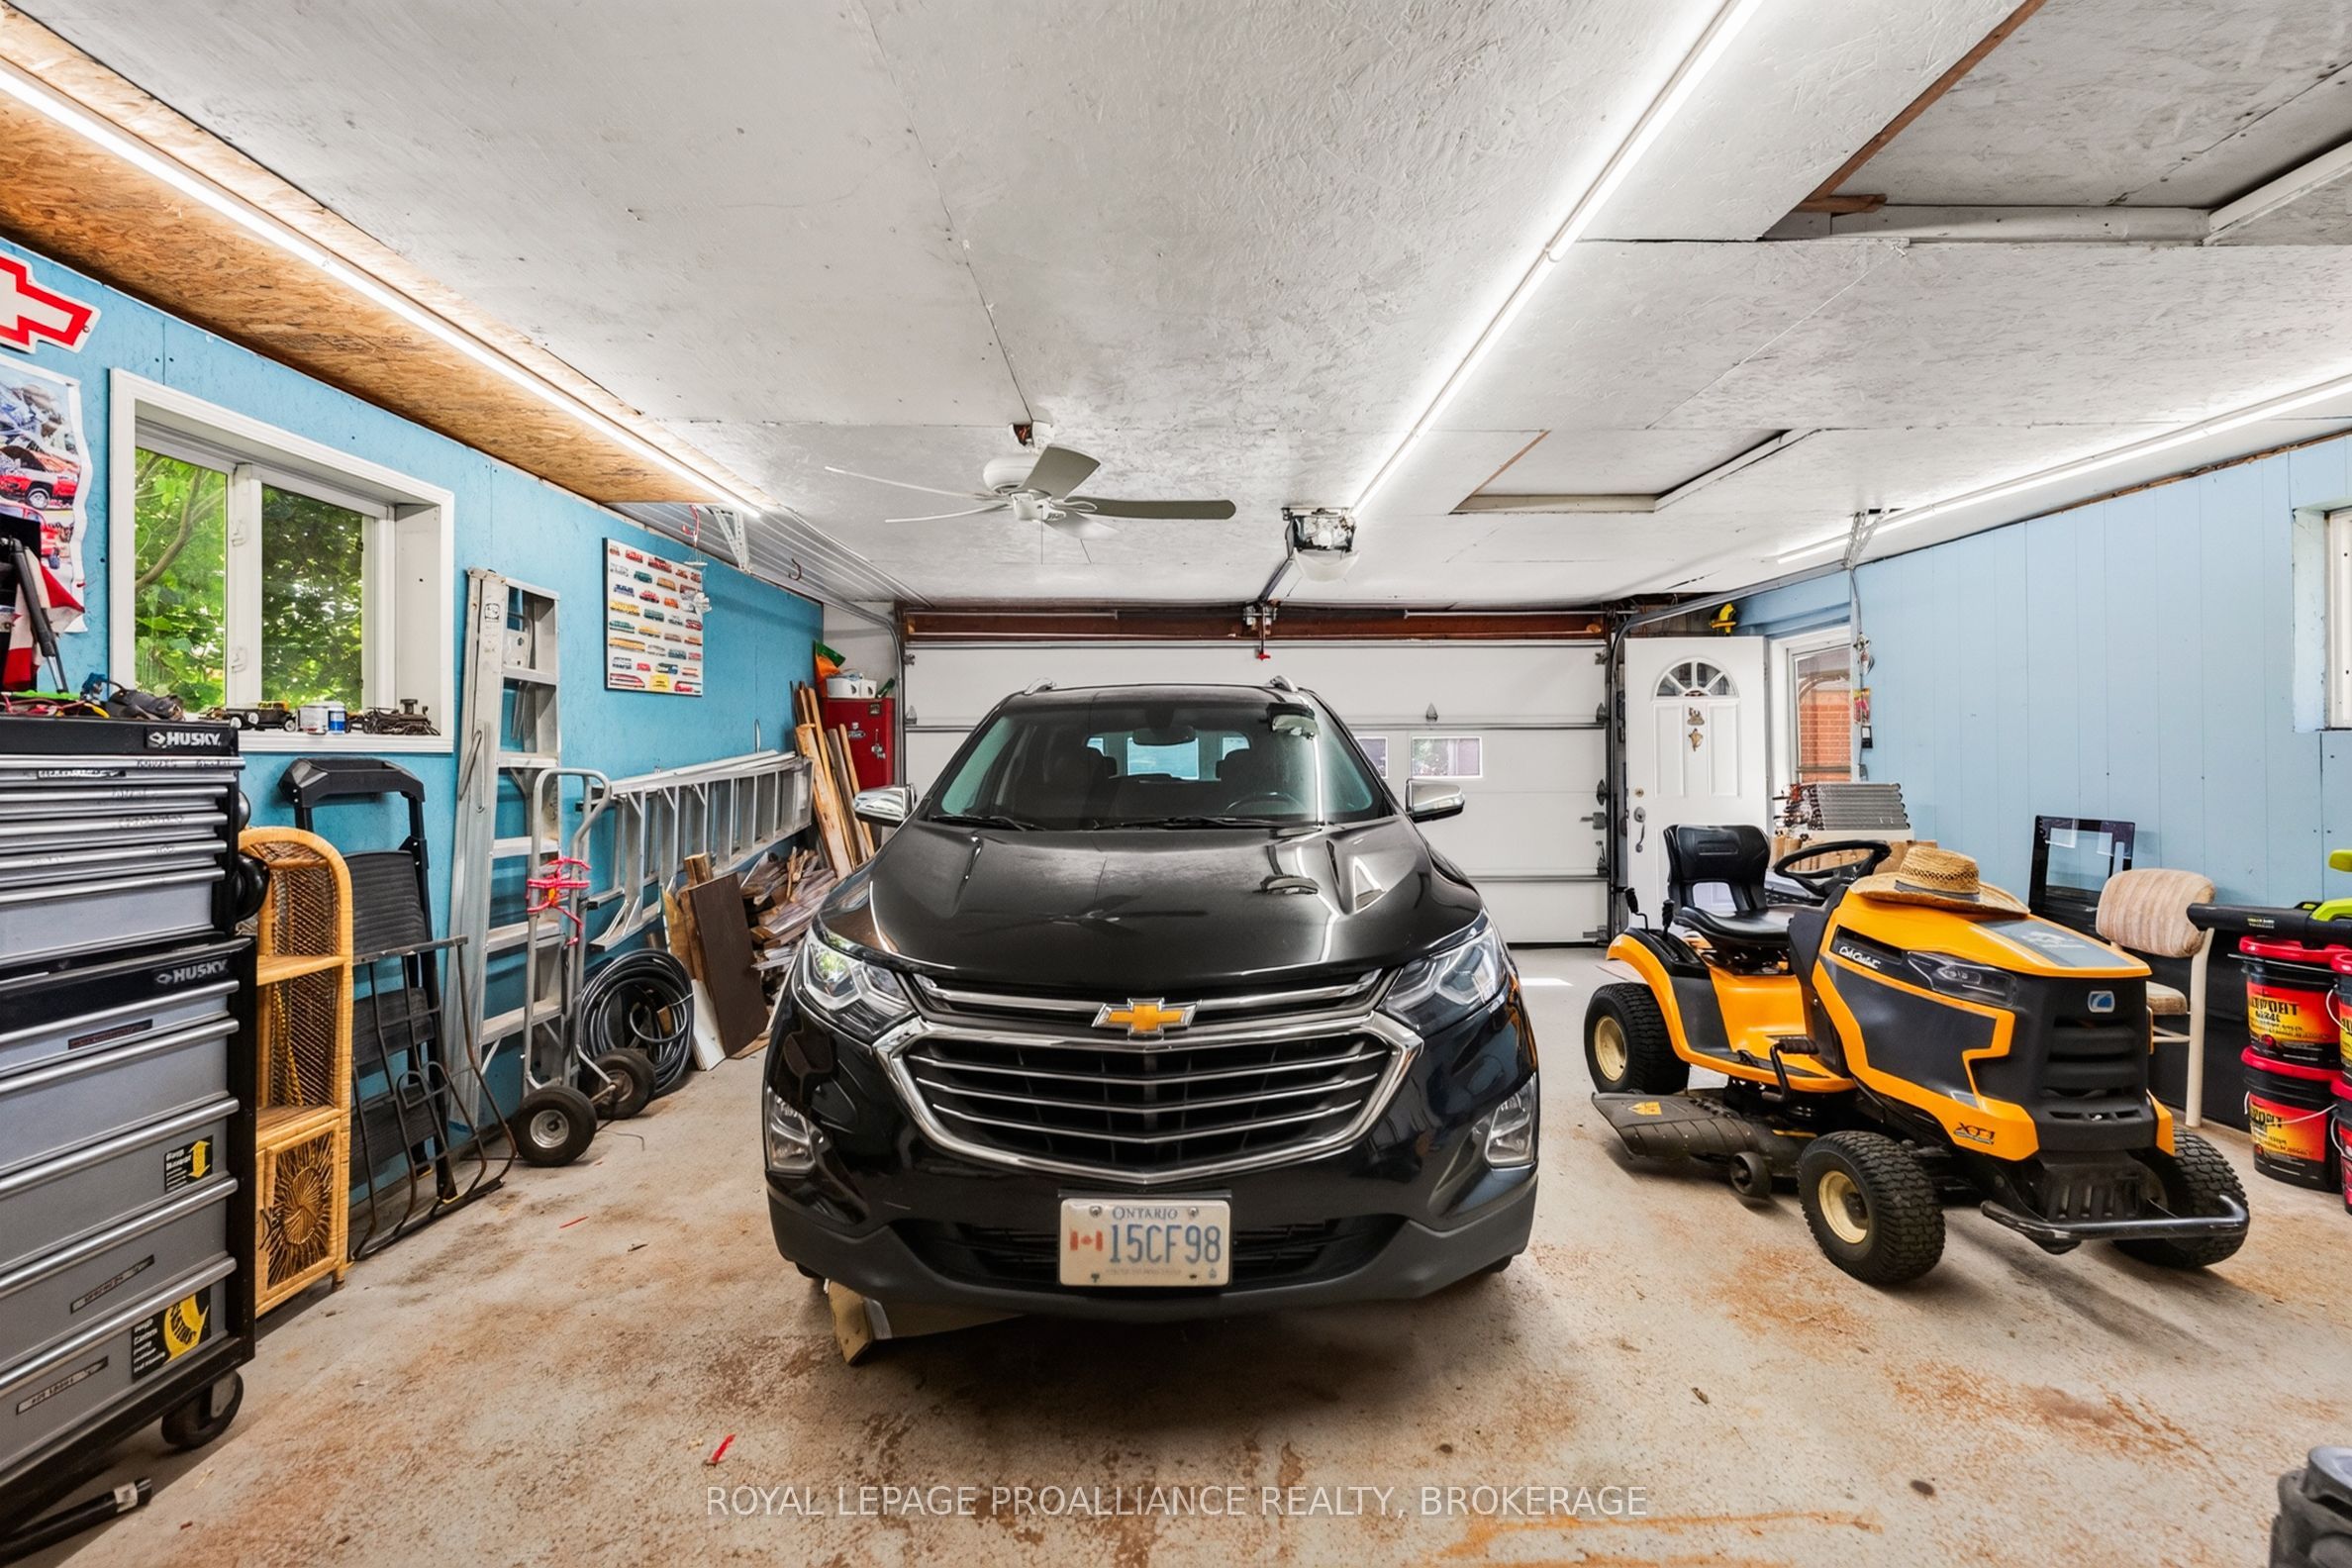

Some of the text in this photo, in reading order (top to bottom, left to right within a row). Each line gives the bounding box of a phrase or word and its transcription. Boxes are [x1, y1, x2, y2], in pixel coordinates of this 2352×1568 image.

[166, 732, 221, 747] HUSKY
[173, 958, 228, 984] HUSKY
[1109, 1224, 1222, 1264] 15CF98
